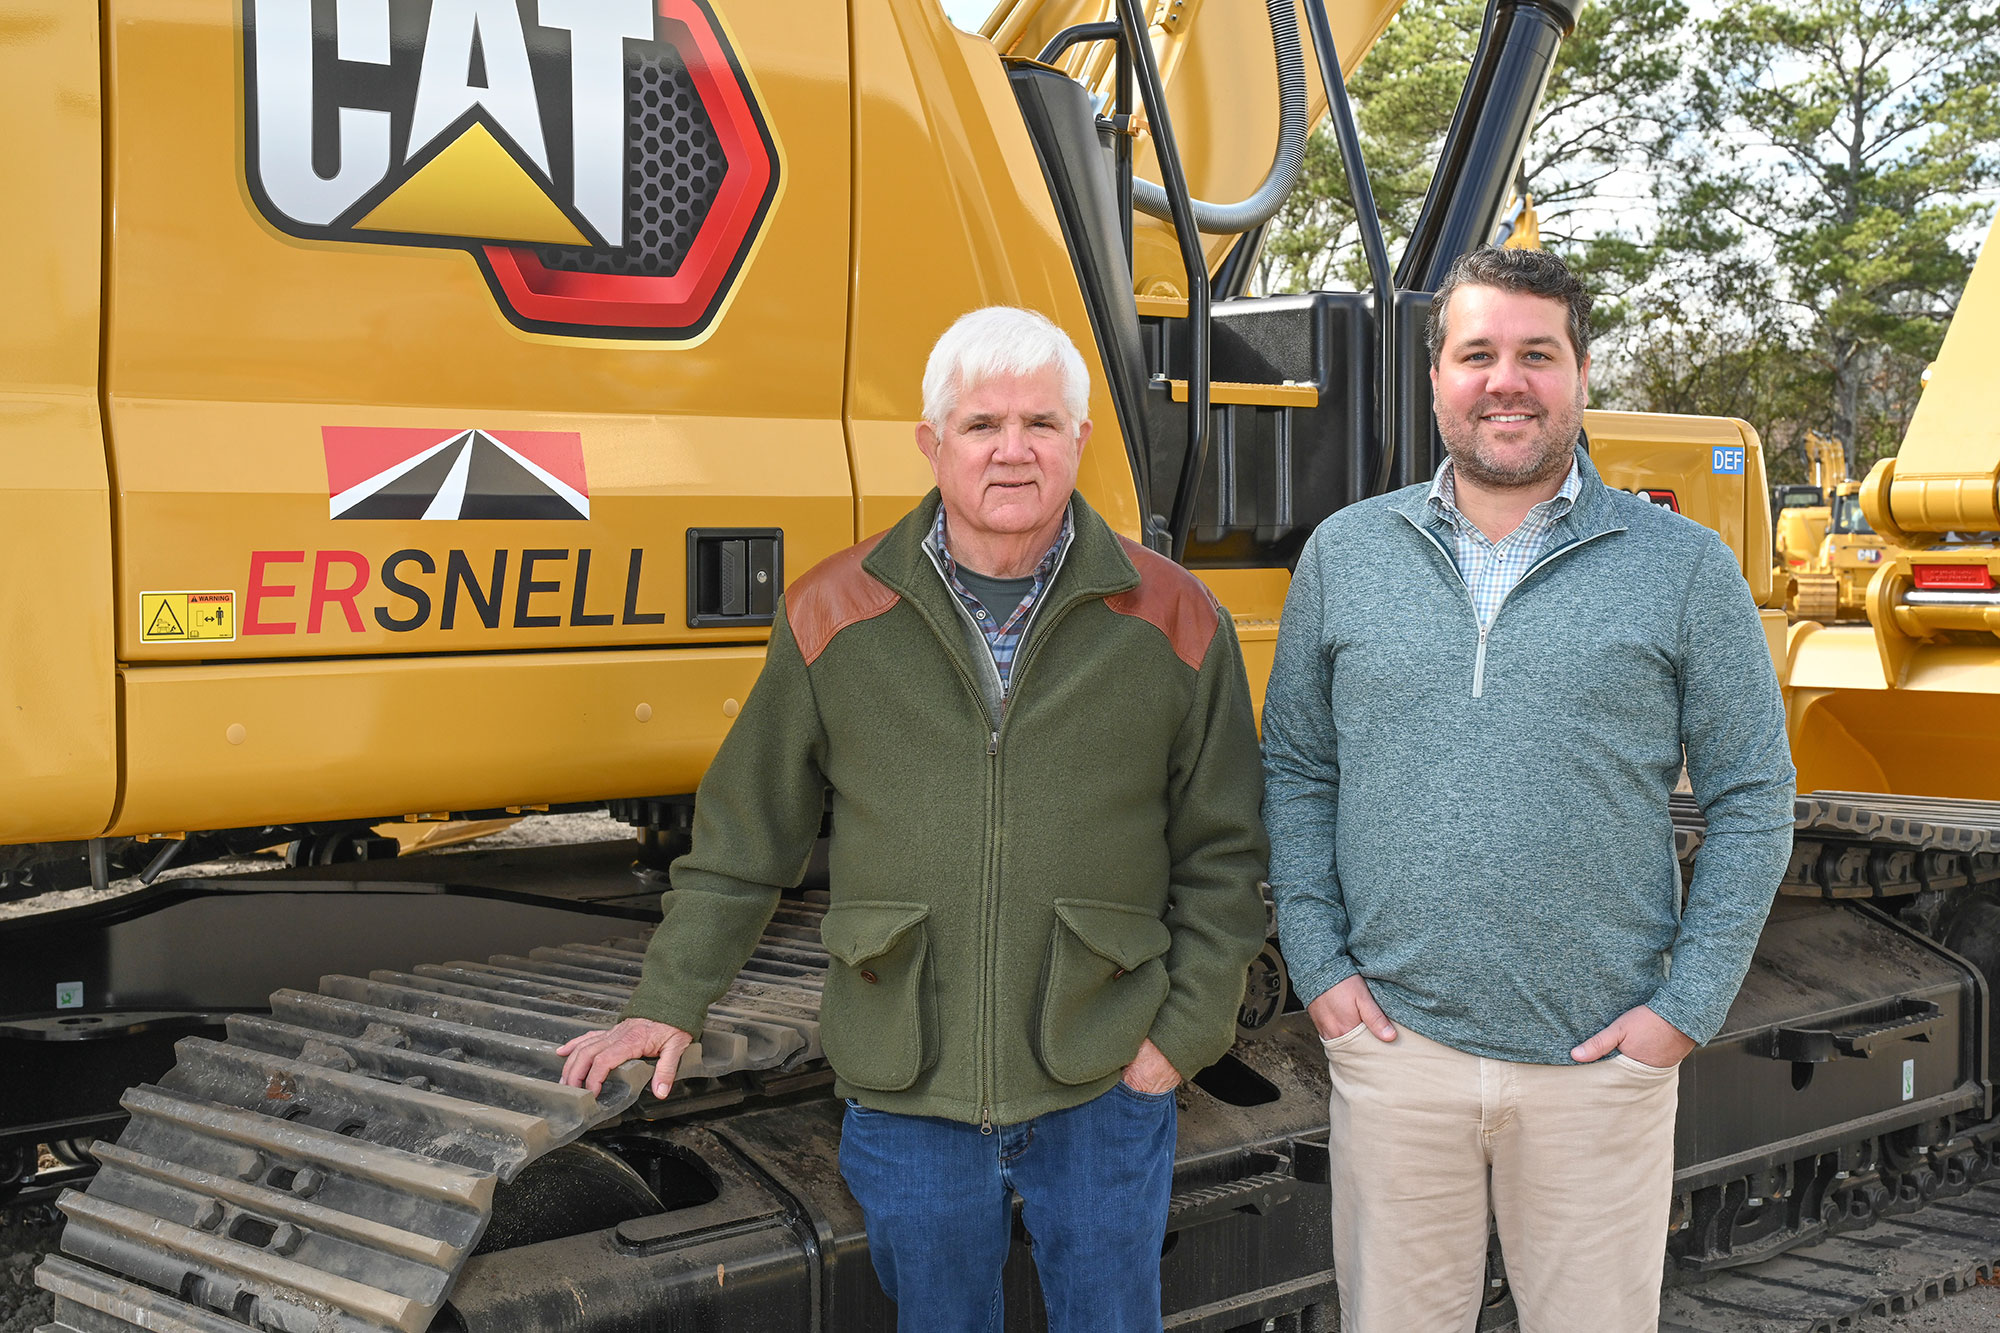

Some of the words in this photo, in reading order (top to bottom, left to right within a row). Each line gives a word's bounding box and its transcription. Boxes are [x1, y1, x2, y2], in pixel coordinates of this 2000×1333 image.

[256, 0, 654, 248] CAT
[1714, 450, 1743, 470] DEF
[1857, 549, 1876, 561] CAT
